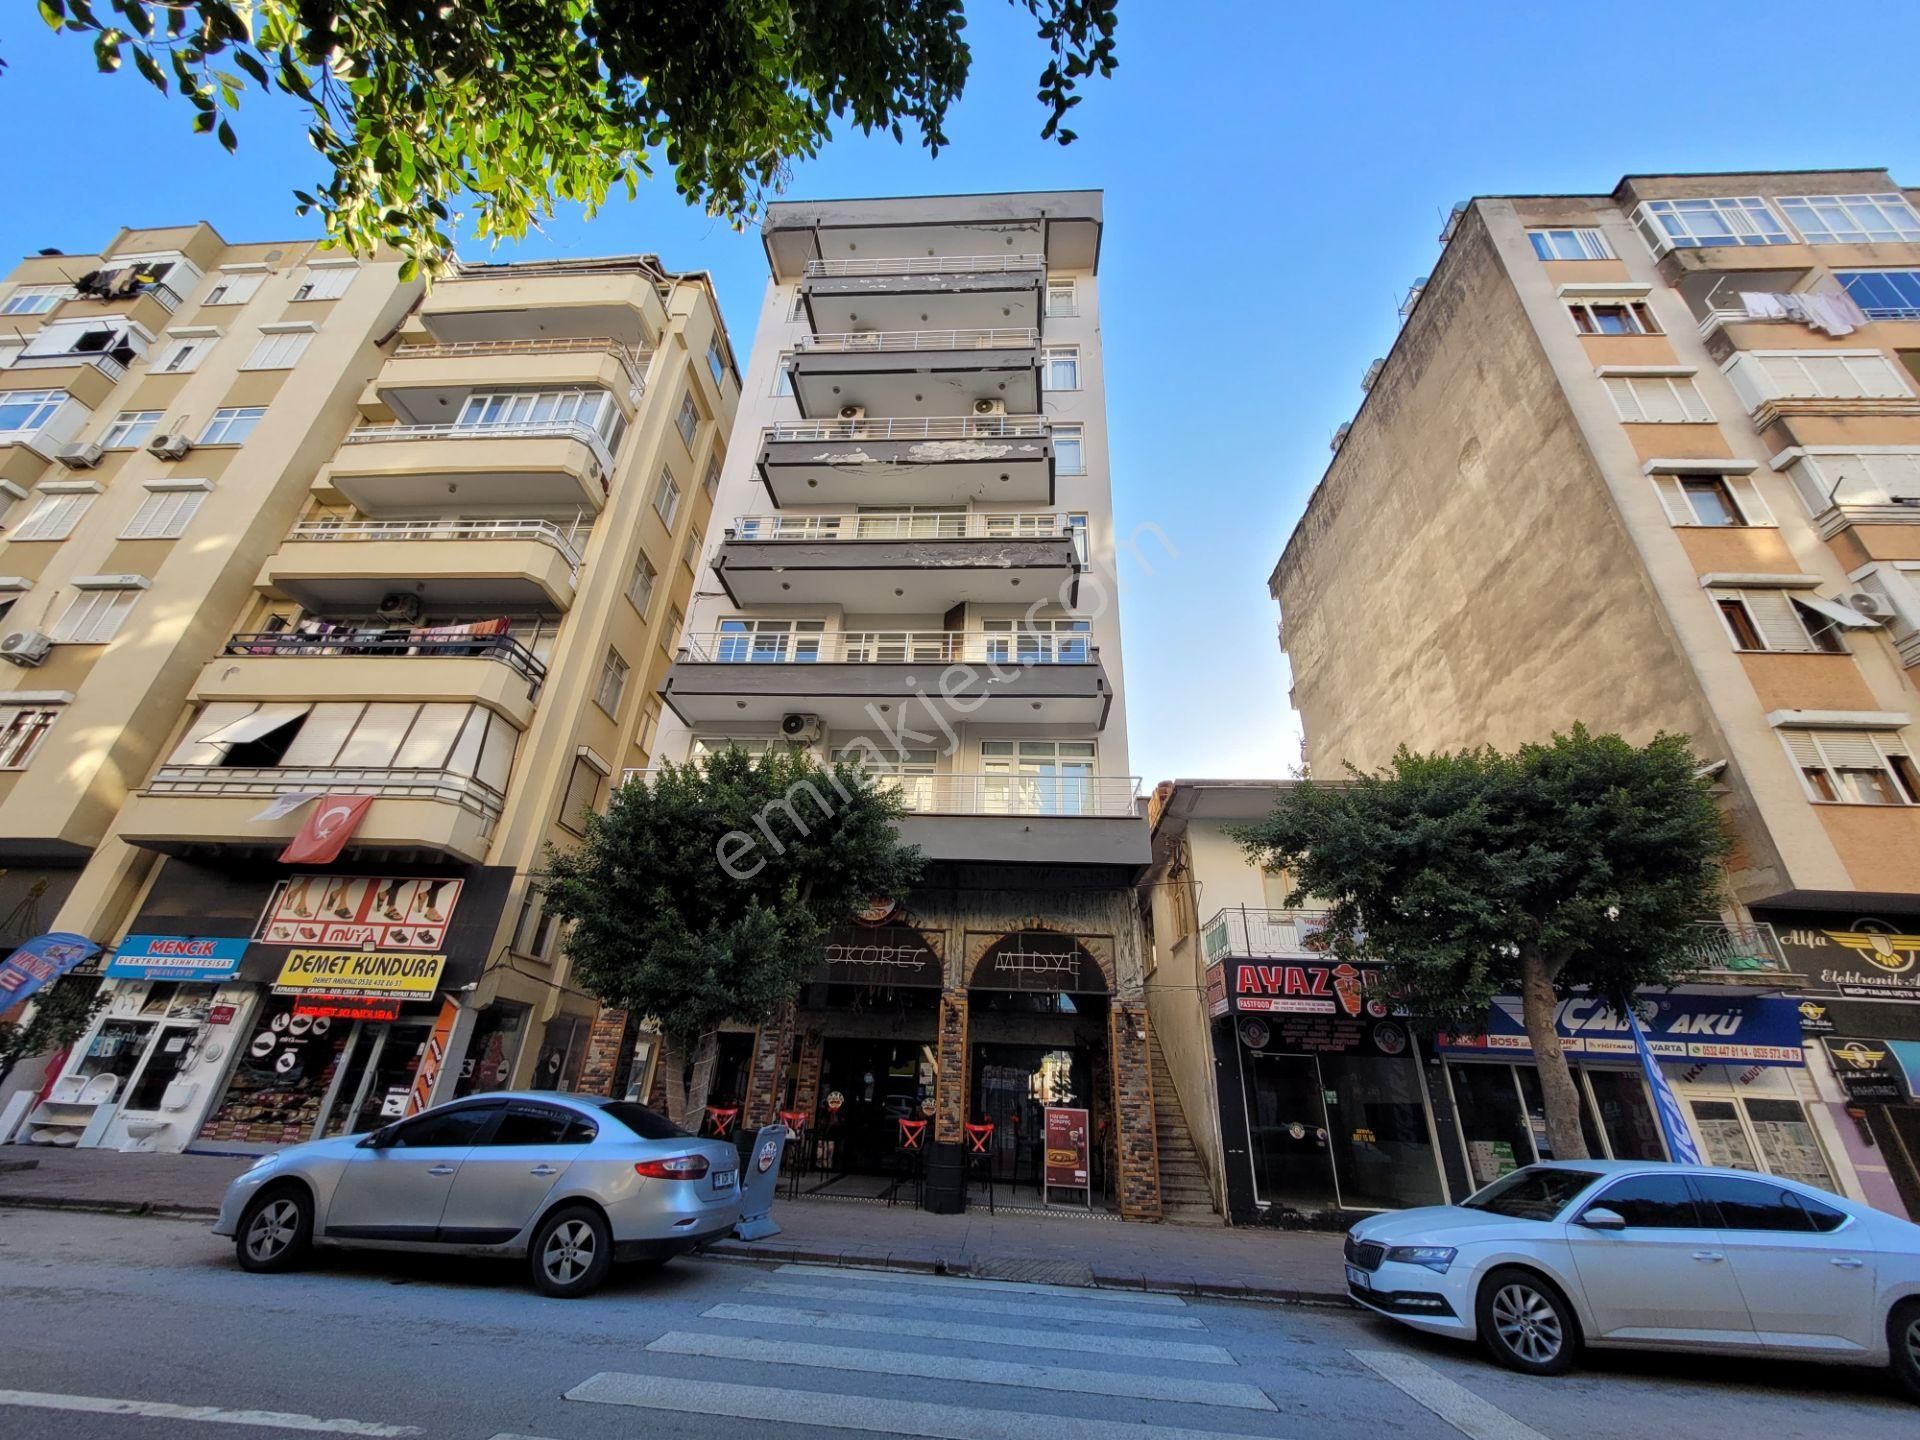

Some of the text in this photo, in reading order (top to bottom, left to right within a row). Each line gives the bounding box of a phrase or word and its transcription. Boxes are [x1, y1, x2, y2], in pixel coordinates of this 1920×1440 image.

[1780, 929, 1829, 949] Alfa
[288, 953, 439, 978] DEMET KUNDURA
[824, 943, 929, 973] OKOREÇ
[1236, 964, 1334, 997] AYAZ
[1820, 968, 1903, 987] Elektronik
[1239, 998, 1271, 1010] FASTFOOD
[1666, 1008, 1745, 1036] AKÜ
[1490, 1037, 1520, 1047] BOSS
[1651, 1044, 1683, 1052] VARTA
[1702, 1045, 1718, 1057] 0532
